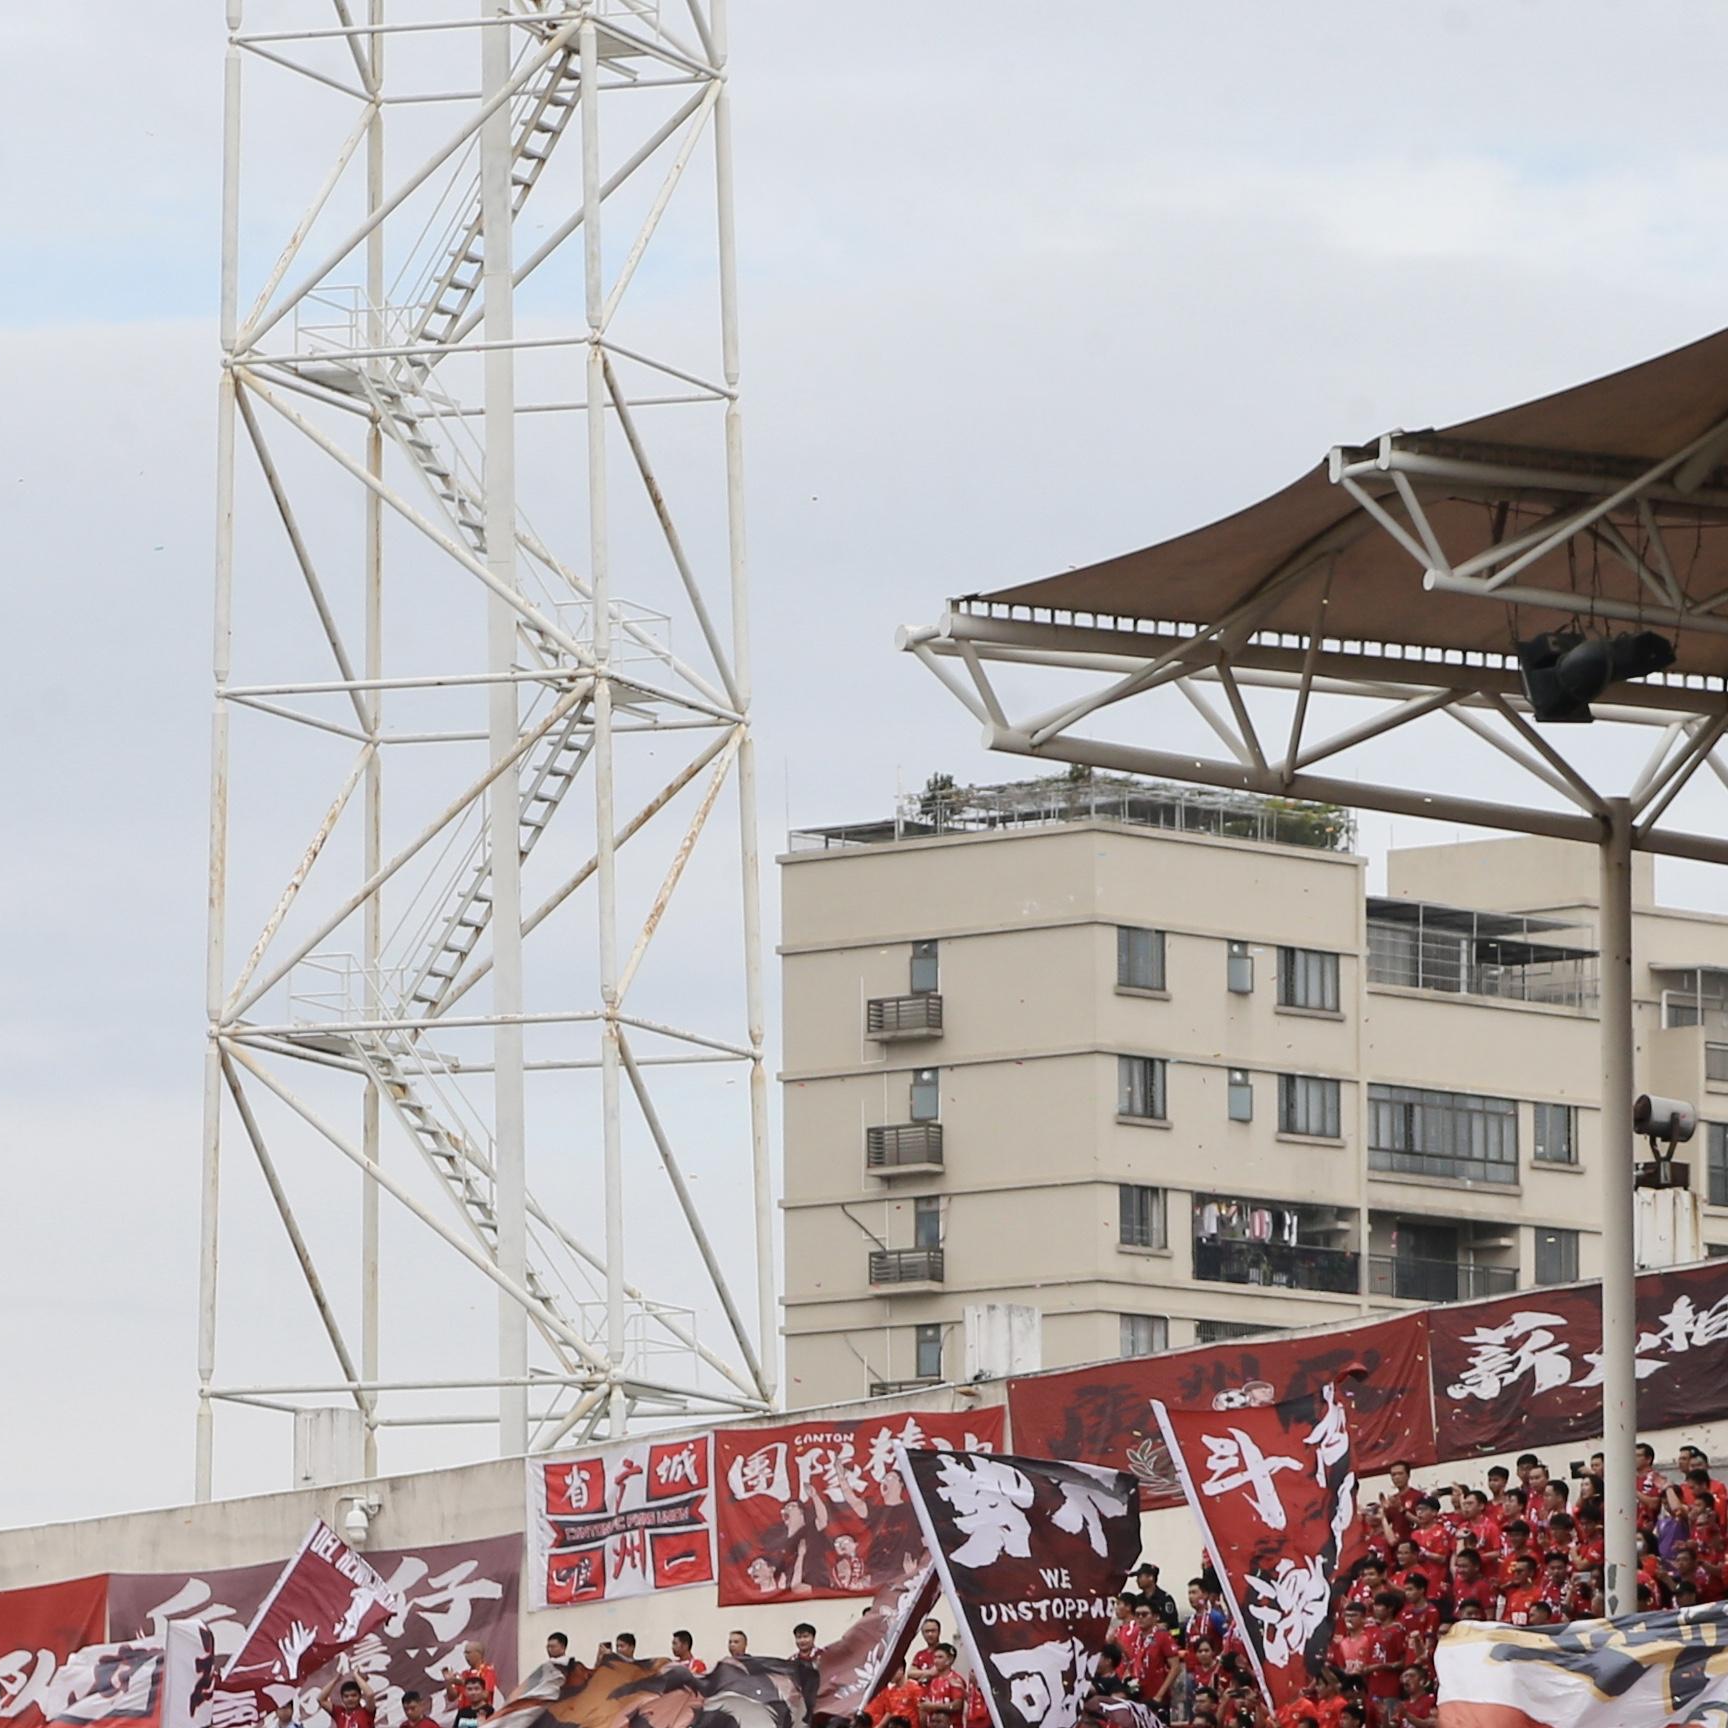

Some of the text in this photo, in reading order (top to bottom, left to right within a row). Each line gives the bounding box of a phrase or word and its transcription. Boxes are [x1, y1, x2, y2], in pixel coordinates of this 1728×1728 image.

[795, 1431, 855, 1445] CANTON
[561, 1466, 591, 1511] 省
[656, 1443, 699, 1487] 城
[1040, 1567, 1072, 1591] WE
